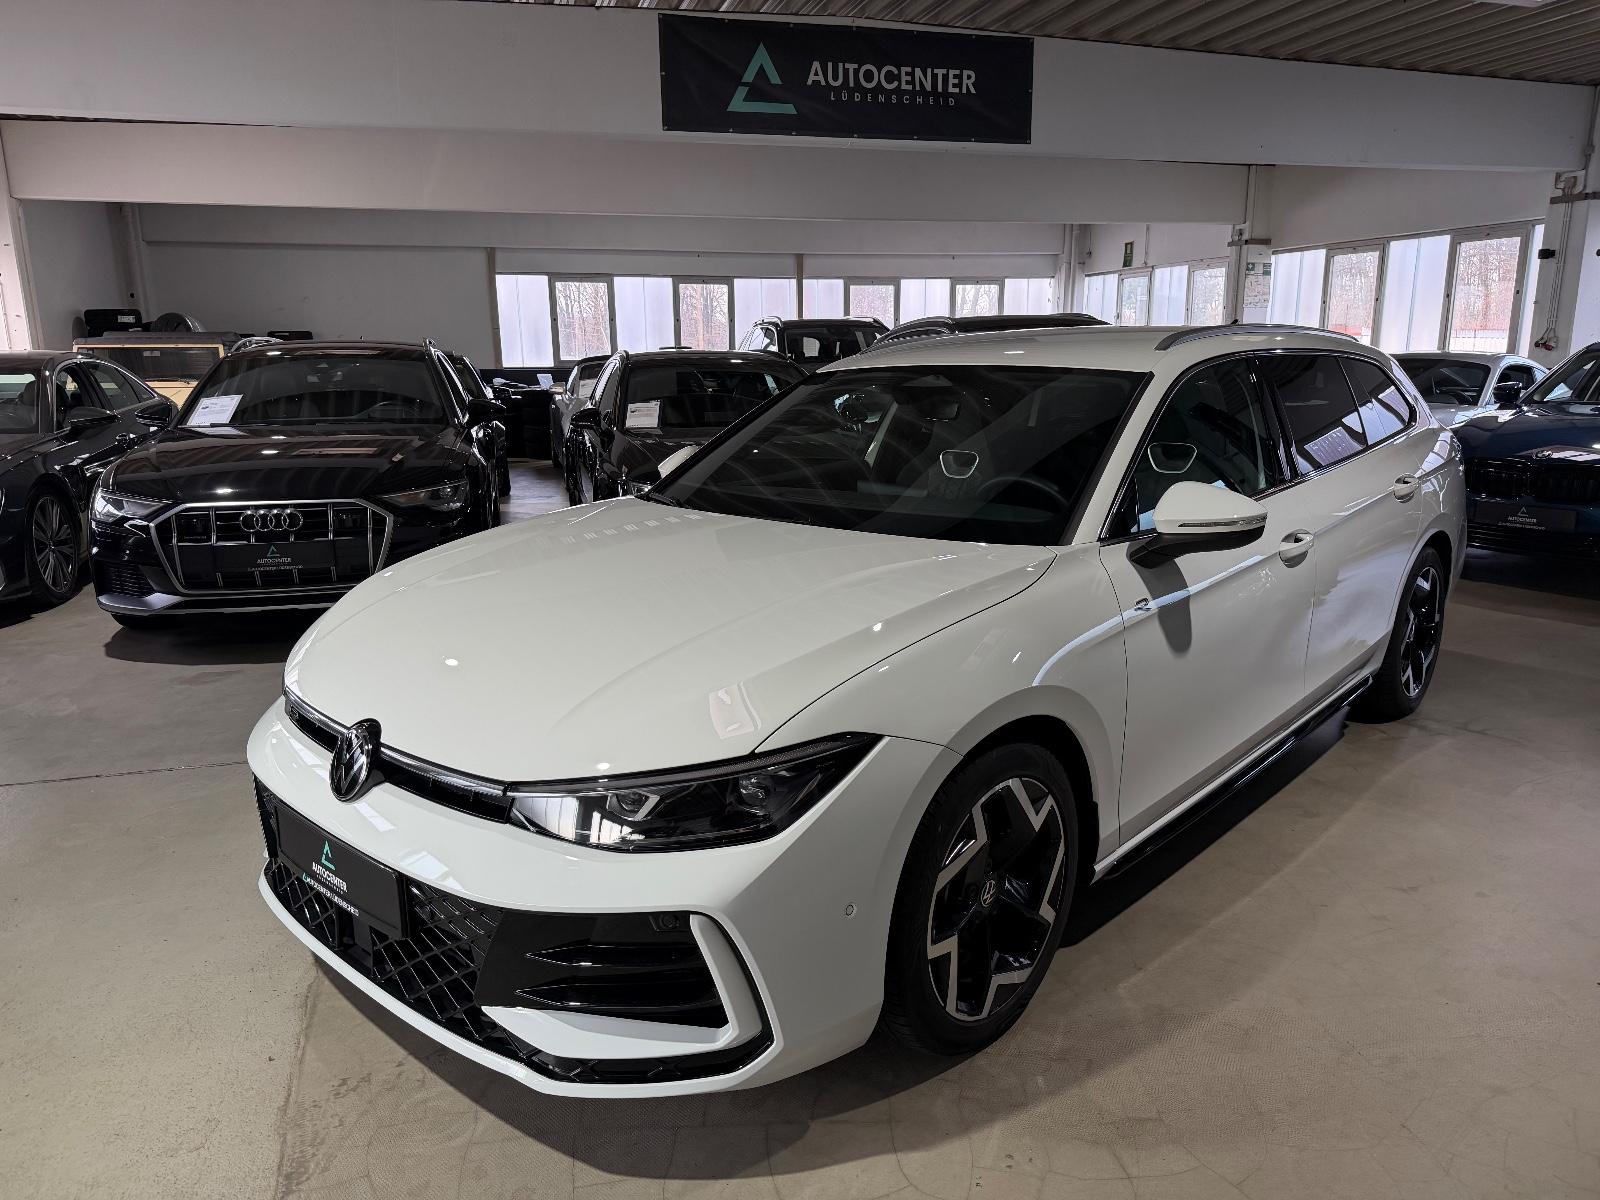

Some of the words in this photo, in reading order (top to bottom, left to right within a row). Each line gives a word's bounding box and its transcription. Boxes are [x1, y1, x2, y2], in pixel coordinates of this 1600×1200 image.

[806, 60, 976, 94] AUTOCENTER
[831, 90, 955, 106] LÜDENSCHEID
[312, 861, 347, 893] AUTOCENTER
